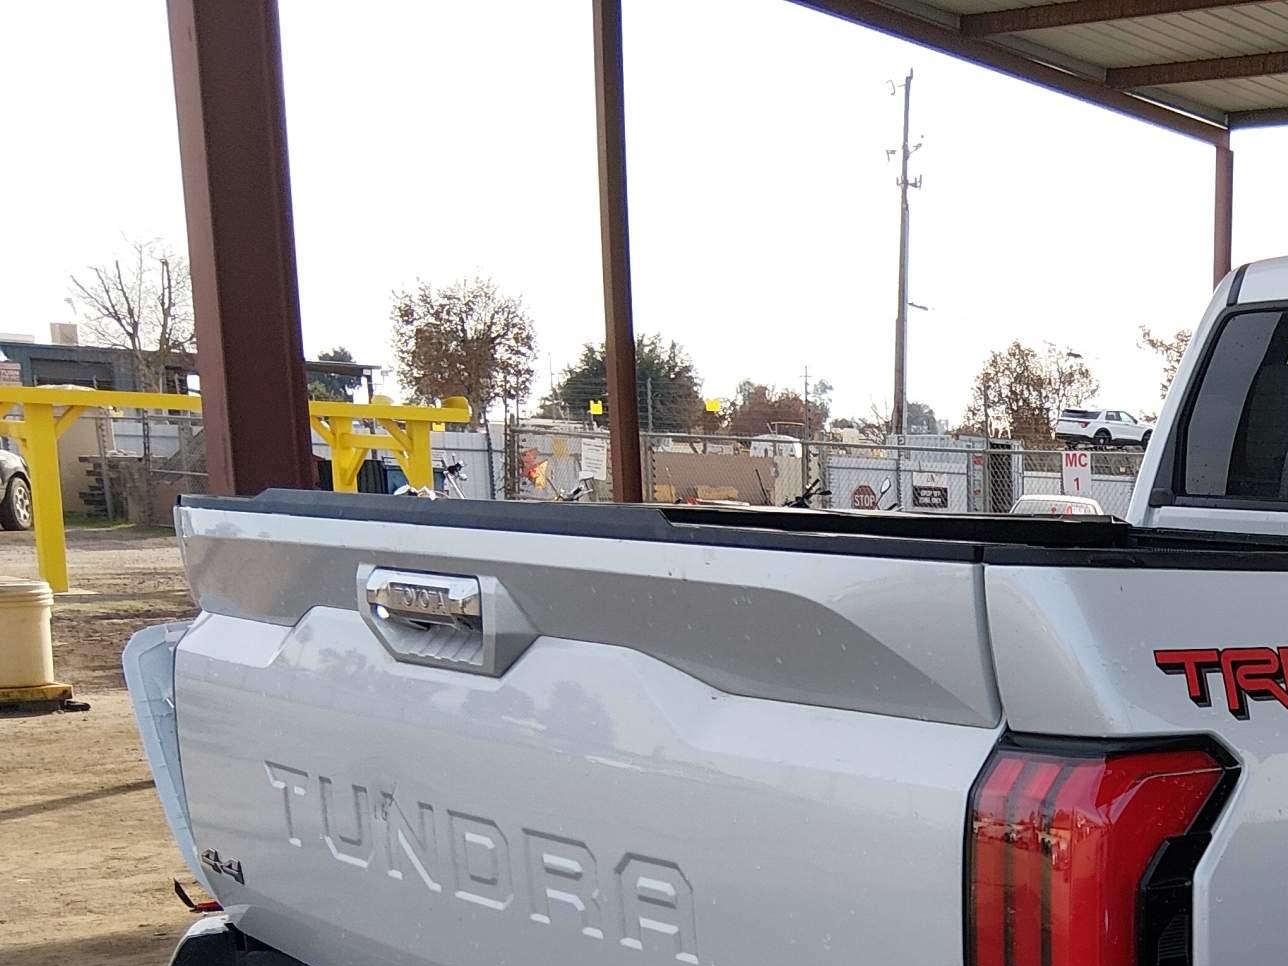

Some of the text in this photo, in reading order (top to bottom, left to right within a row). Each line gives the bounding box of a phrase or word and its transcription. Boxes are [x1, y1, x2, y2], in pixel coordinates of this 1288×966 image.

[1065, 453, 1088, 468] MC
[1073, 477, 1080, 491] 1
[854, 494, 875, 507] STOP
[264, 760, 700, 966] TUNDRA
